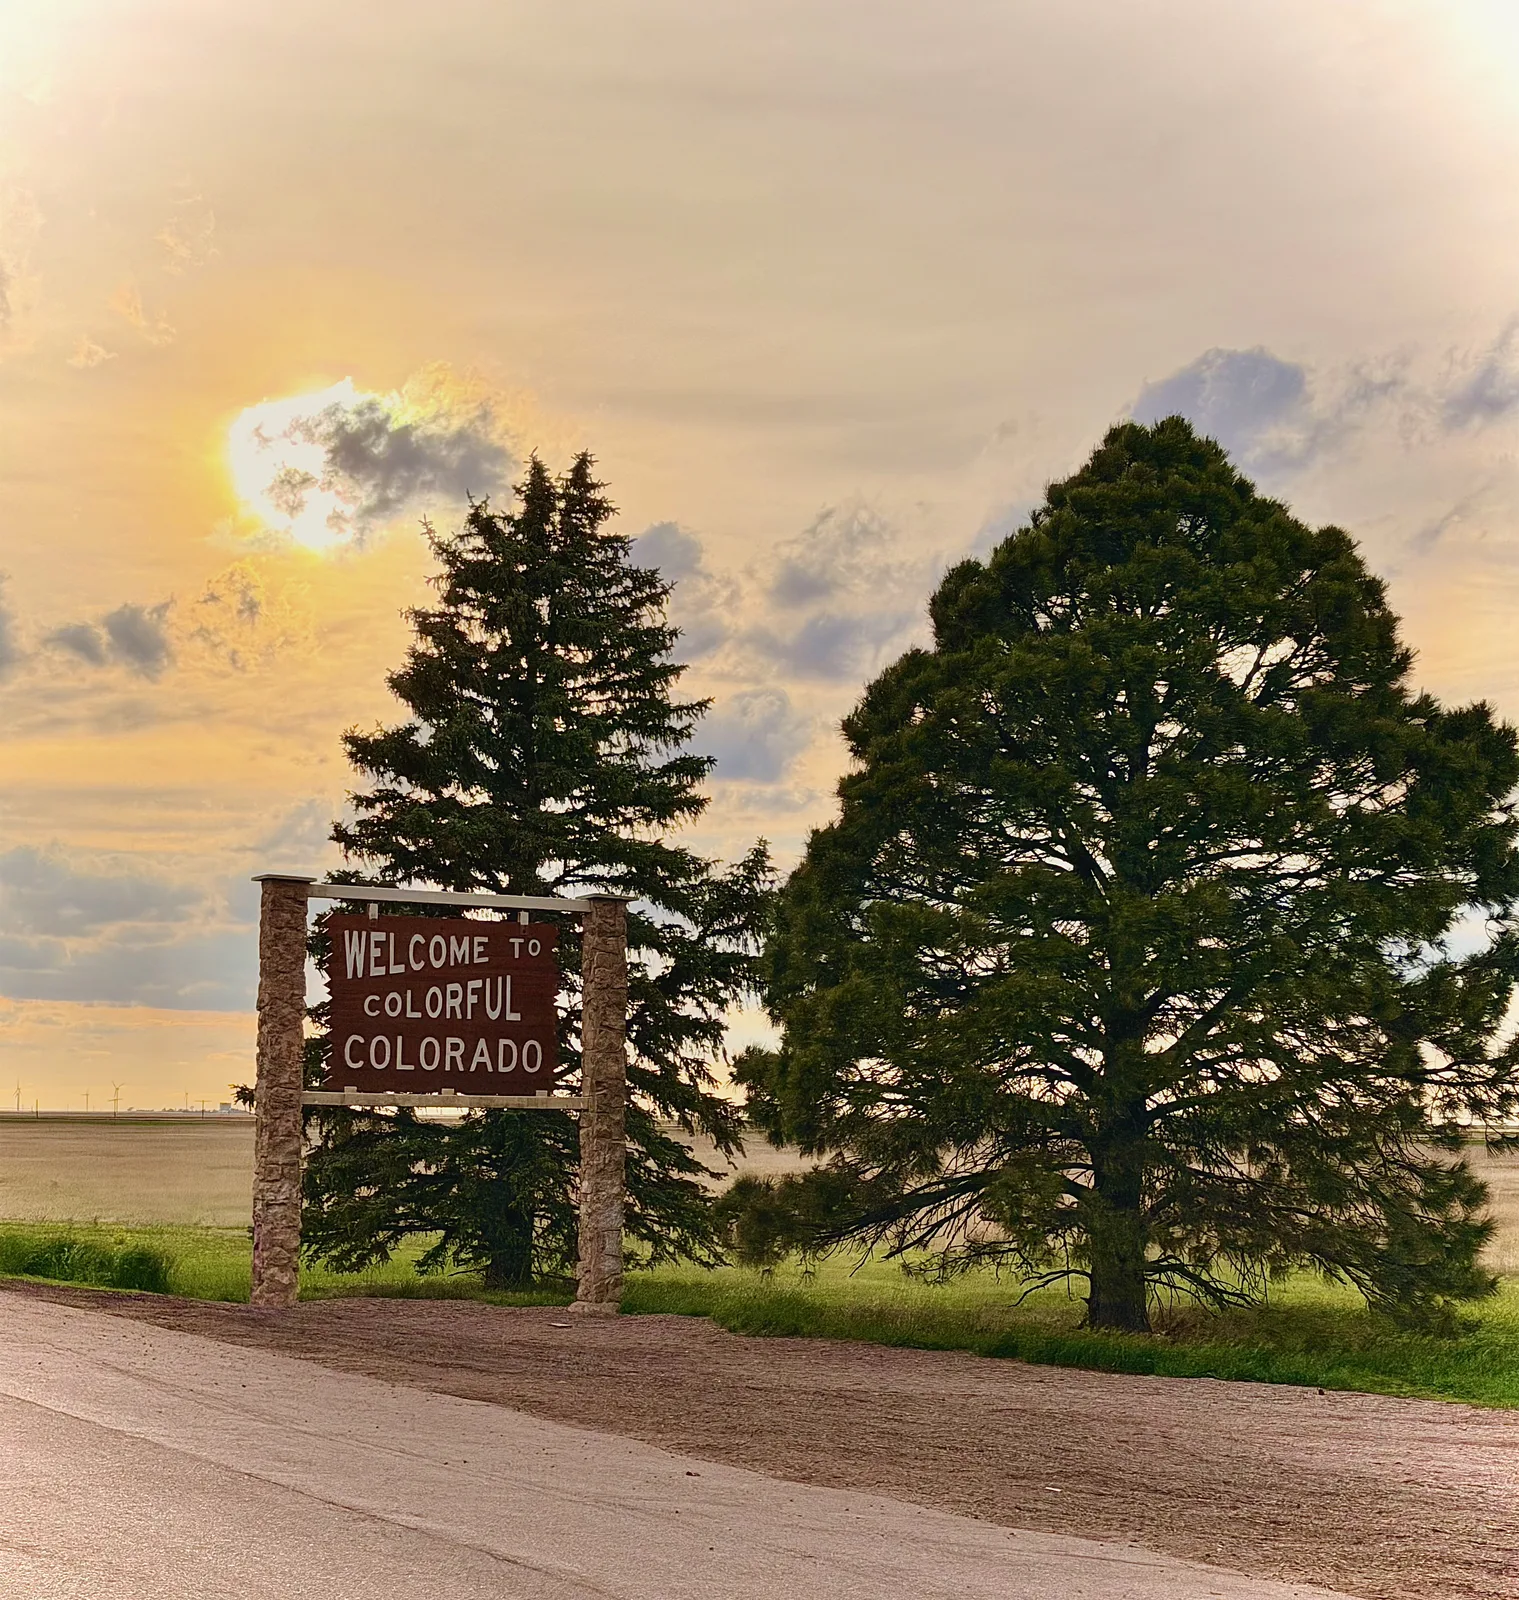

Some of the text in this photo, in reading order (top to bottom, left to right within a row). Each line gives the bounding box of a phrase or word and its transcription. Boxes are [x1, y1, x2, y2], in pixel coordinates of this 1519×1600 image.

[344, 929, 541, 979] WELCOME TO
[363, 975, 521, 1022] COLORFUL
[344, 1034, 543, 1073] COLORADO
